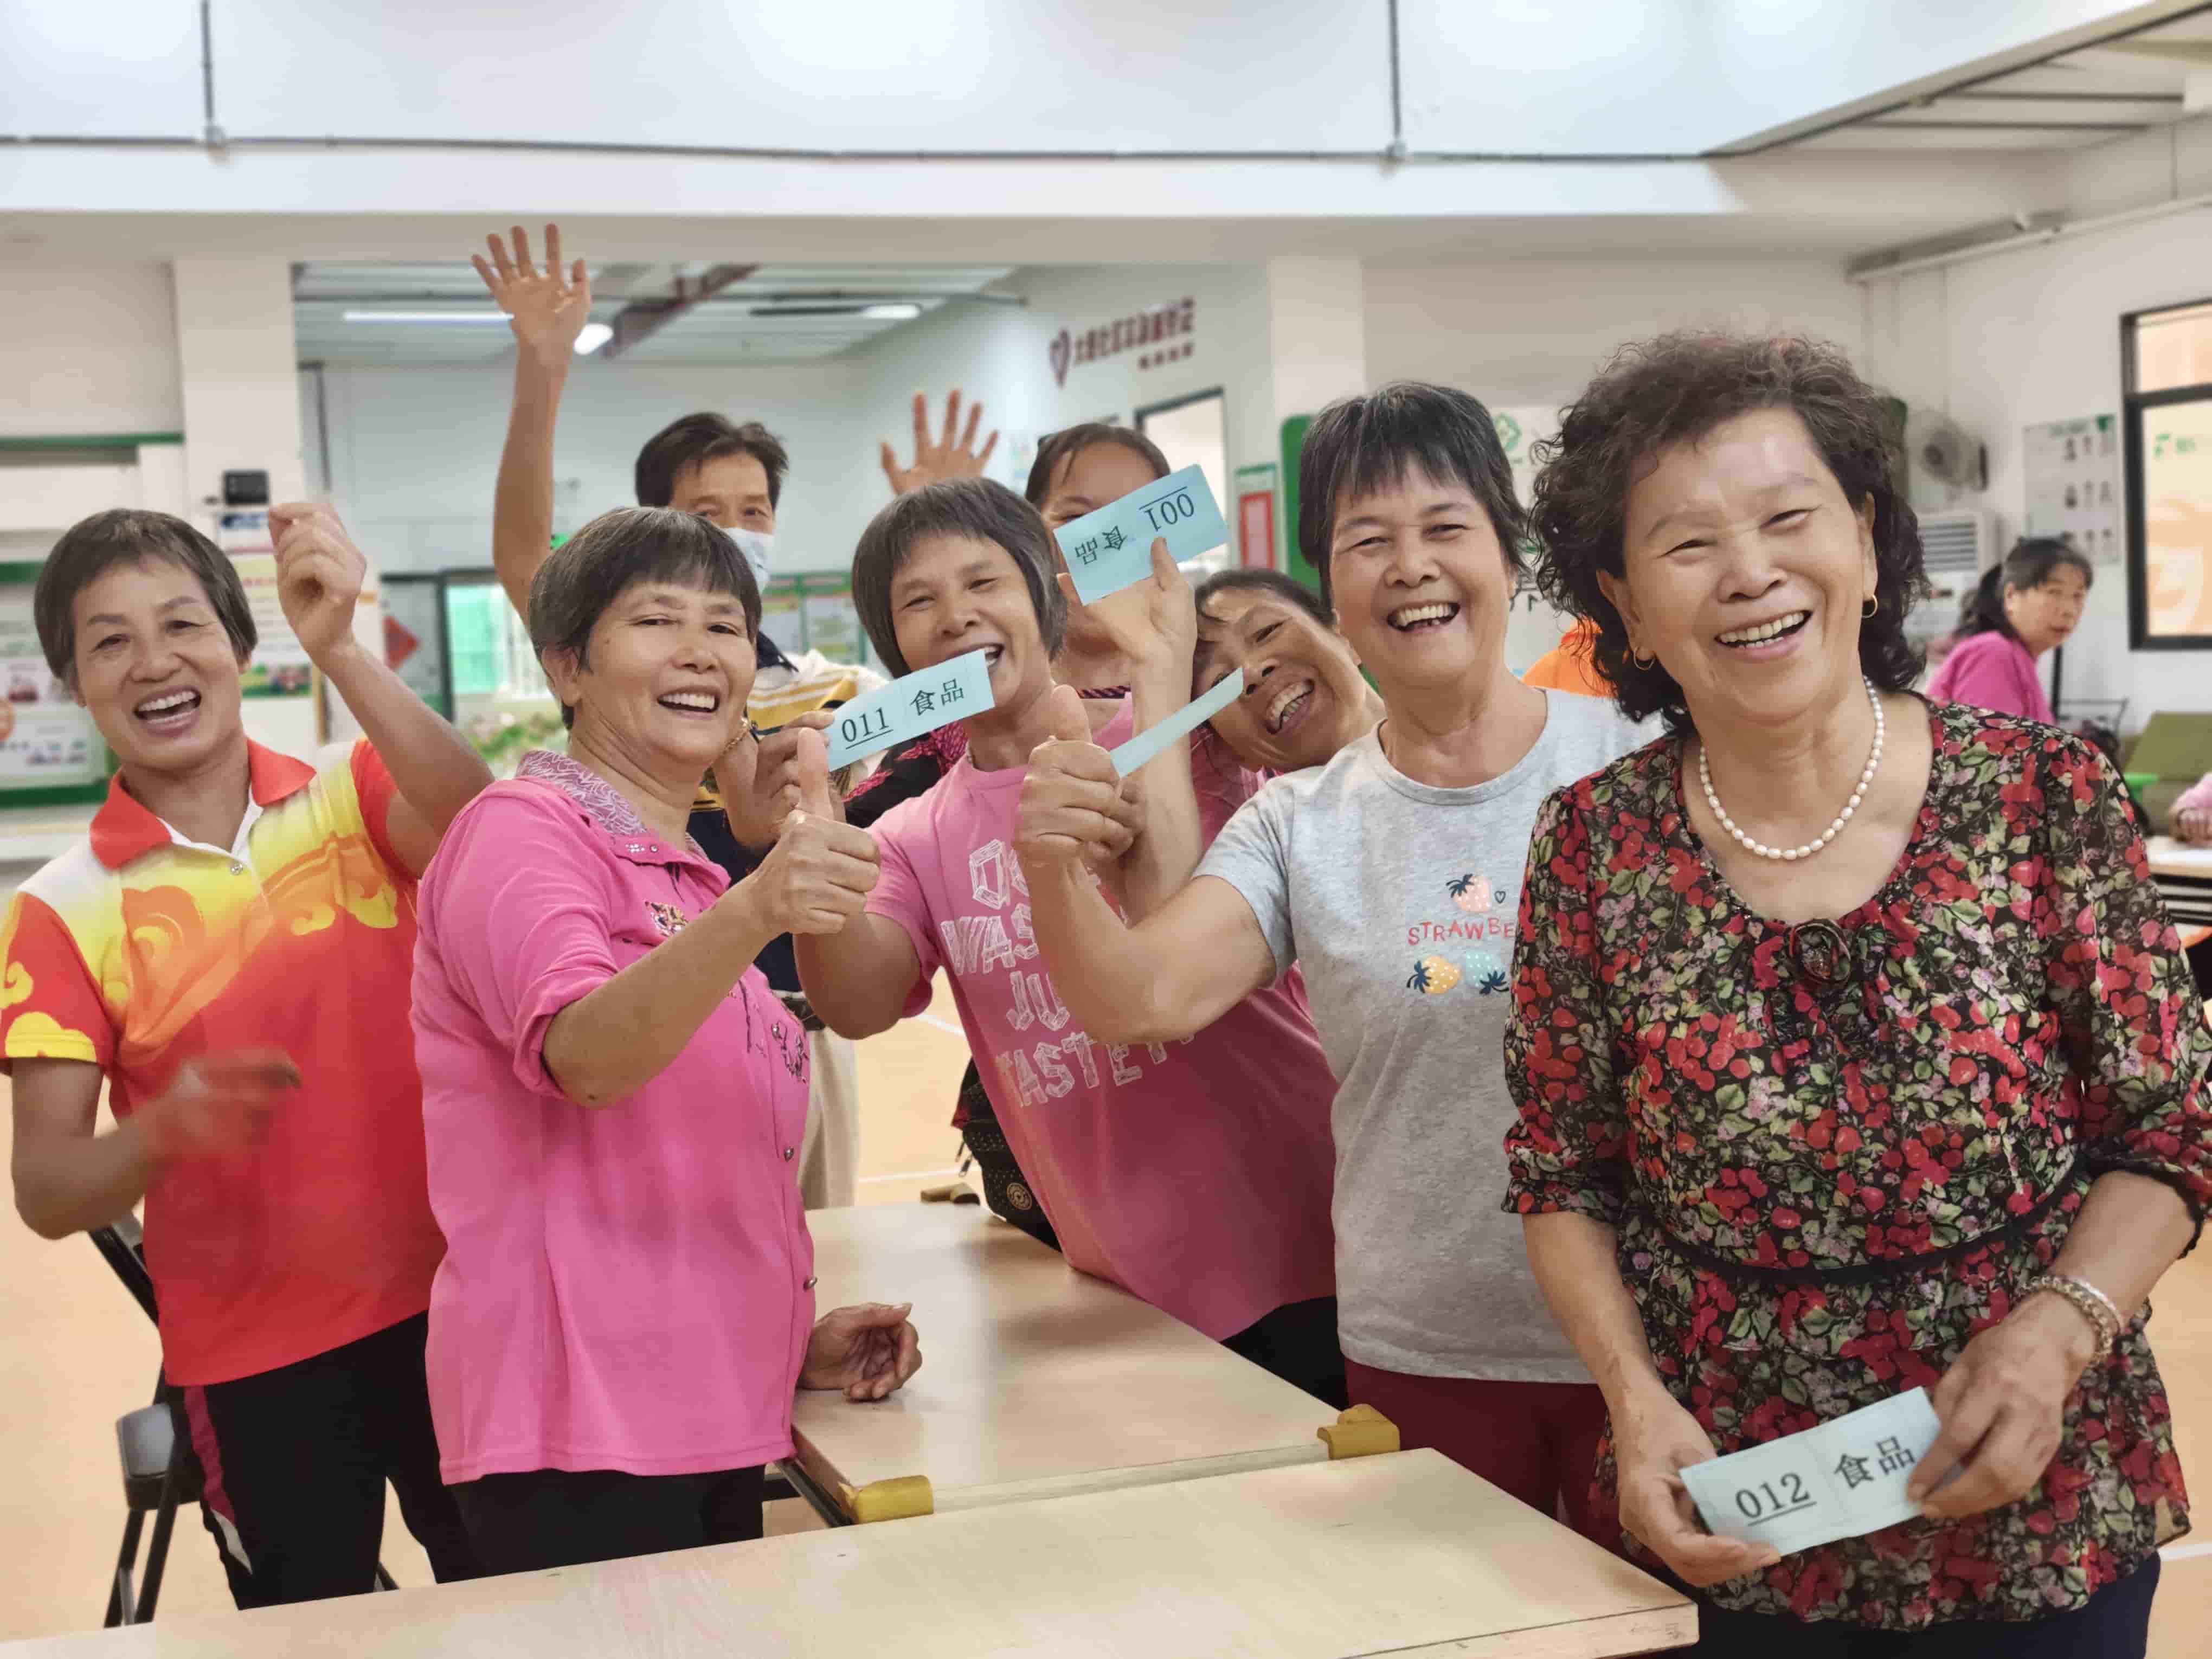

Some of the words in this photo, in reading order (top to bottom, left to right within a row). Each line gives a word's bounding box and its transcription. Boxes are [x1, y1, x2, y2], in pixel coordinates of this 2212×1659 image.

[1143, 493, 1195, 532] 001
[1074, 525, 1128, 565] 食品
[841, 706, 890, 743] 011
[909, 678, 964, 716] 食品
[1407, 916, 1516, 946] STRAWBE
[1735, 1472, 1811, 1519] 012
[1833, 1436, 1916, 1490] 食品
